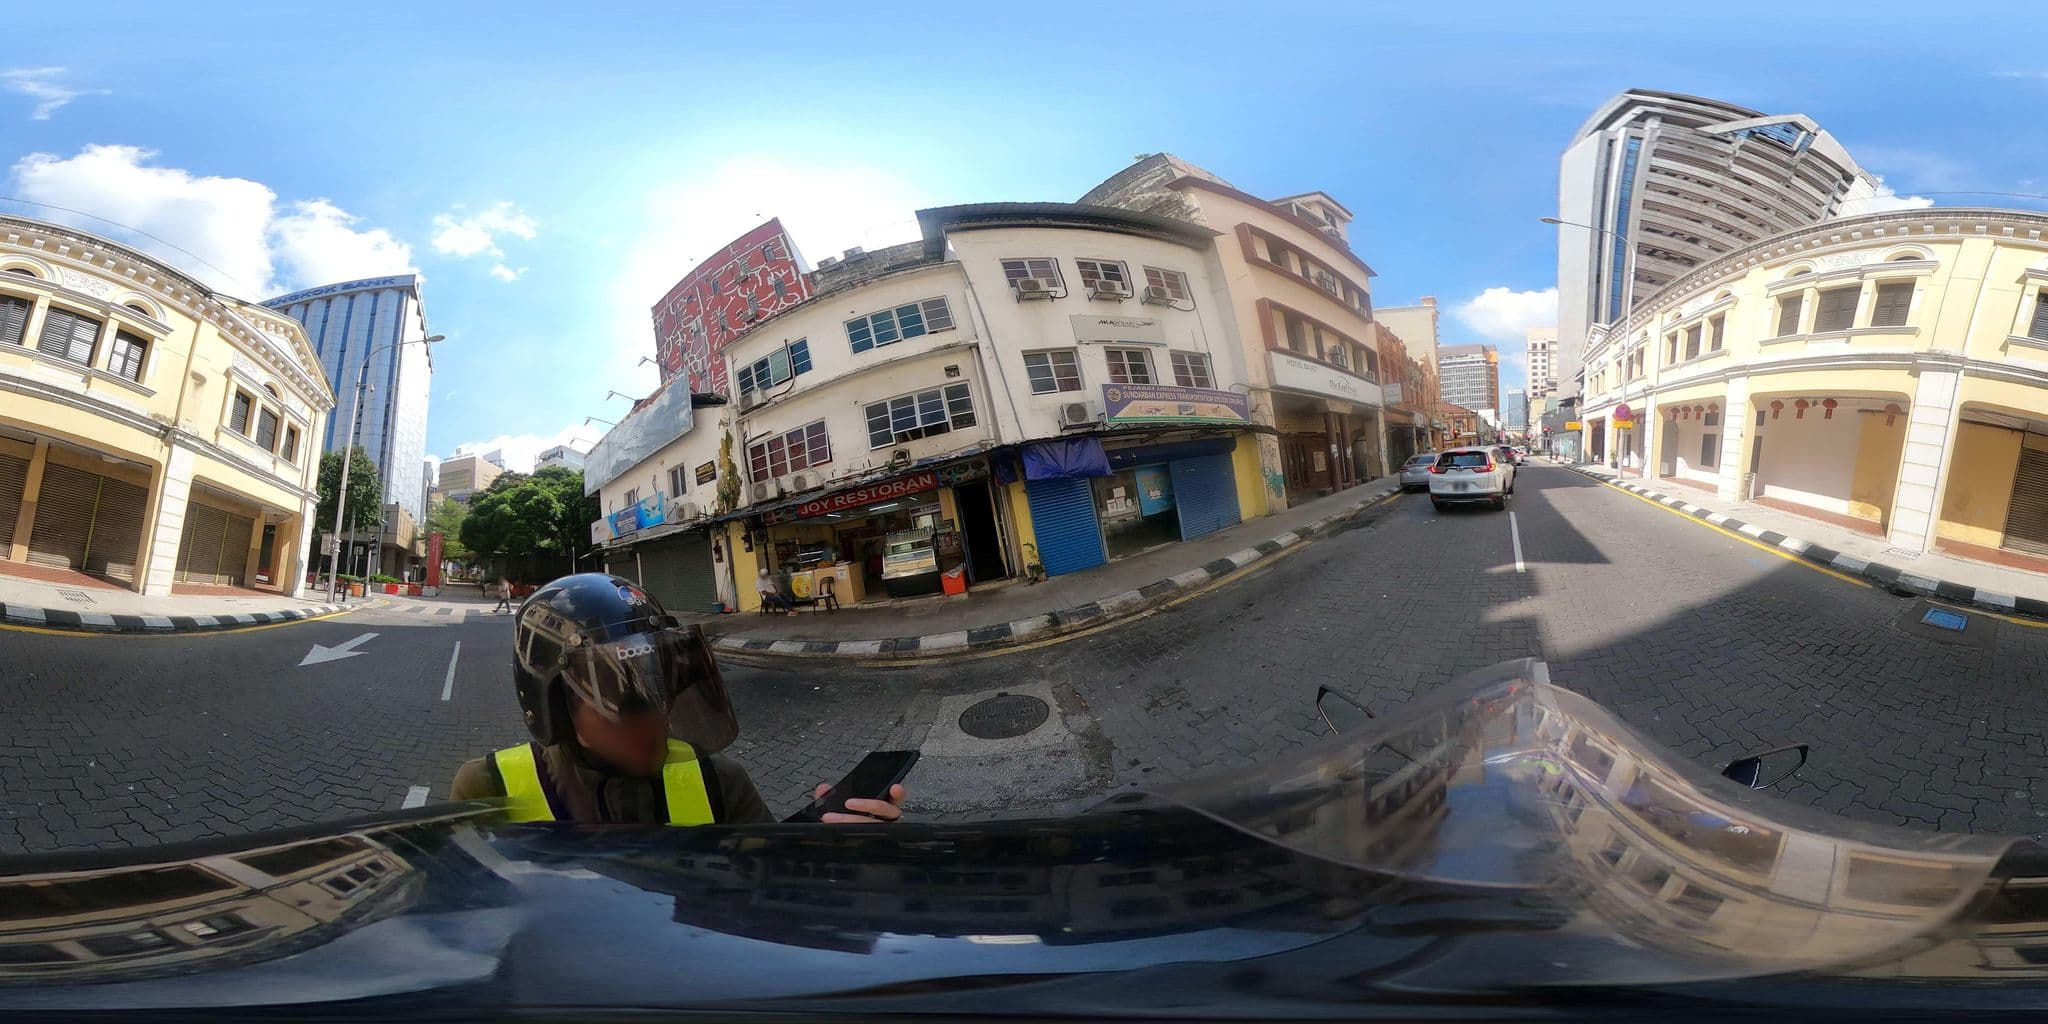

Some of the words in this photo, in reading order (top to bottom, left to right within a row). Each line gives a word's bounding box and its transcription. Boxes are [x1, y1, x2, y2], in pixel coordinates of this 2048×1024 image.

[267, 286, 337, 306] ANGKOK
[342, 278, 395, 290] BANK
[801, 499, 832, 516] JOY
[834, 474, 933, 506] RESTORAN
